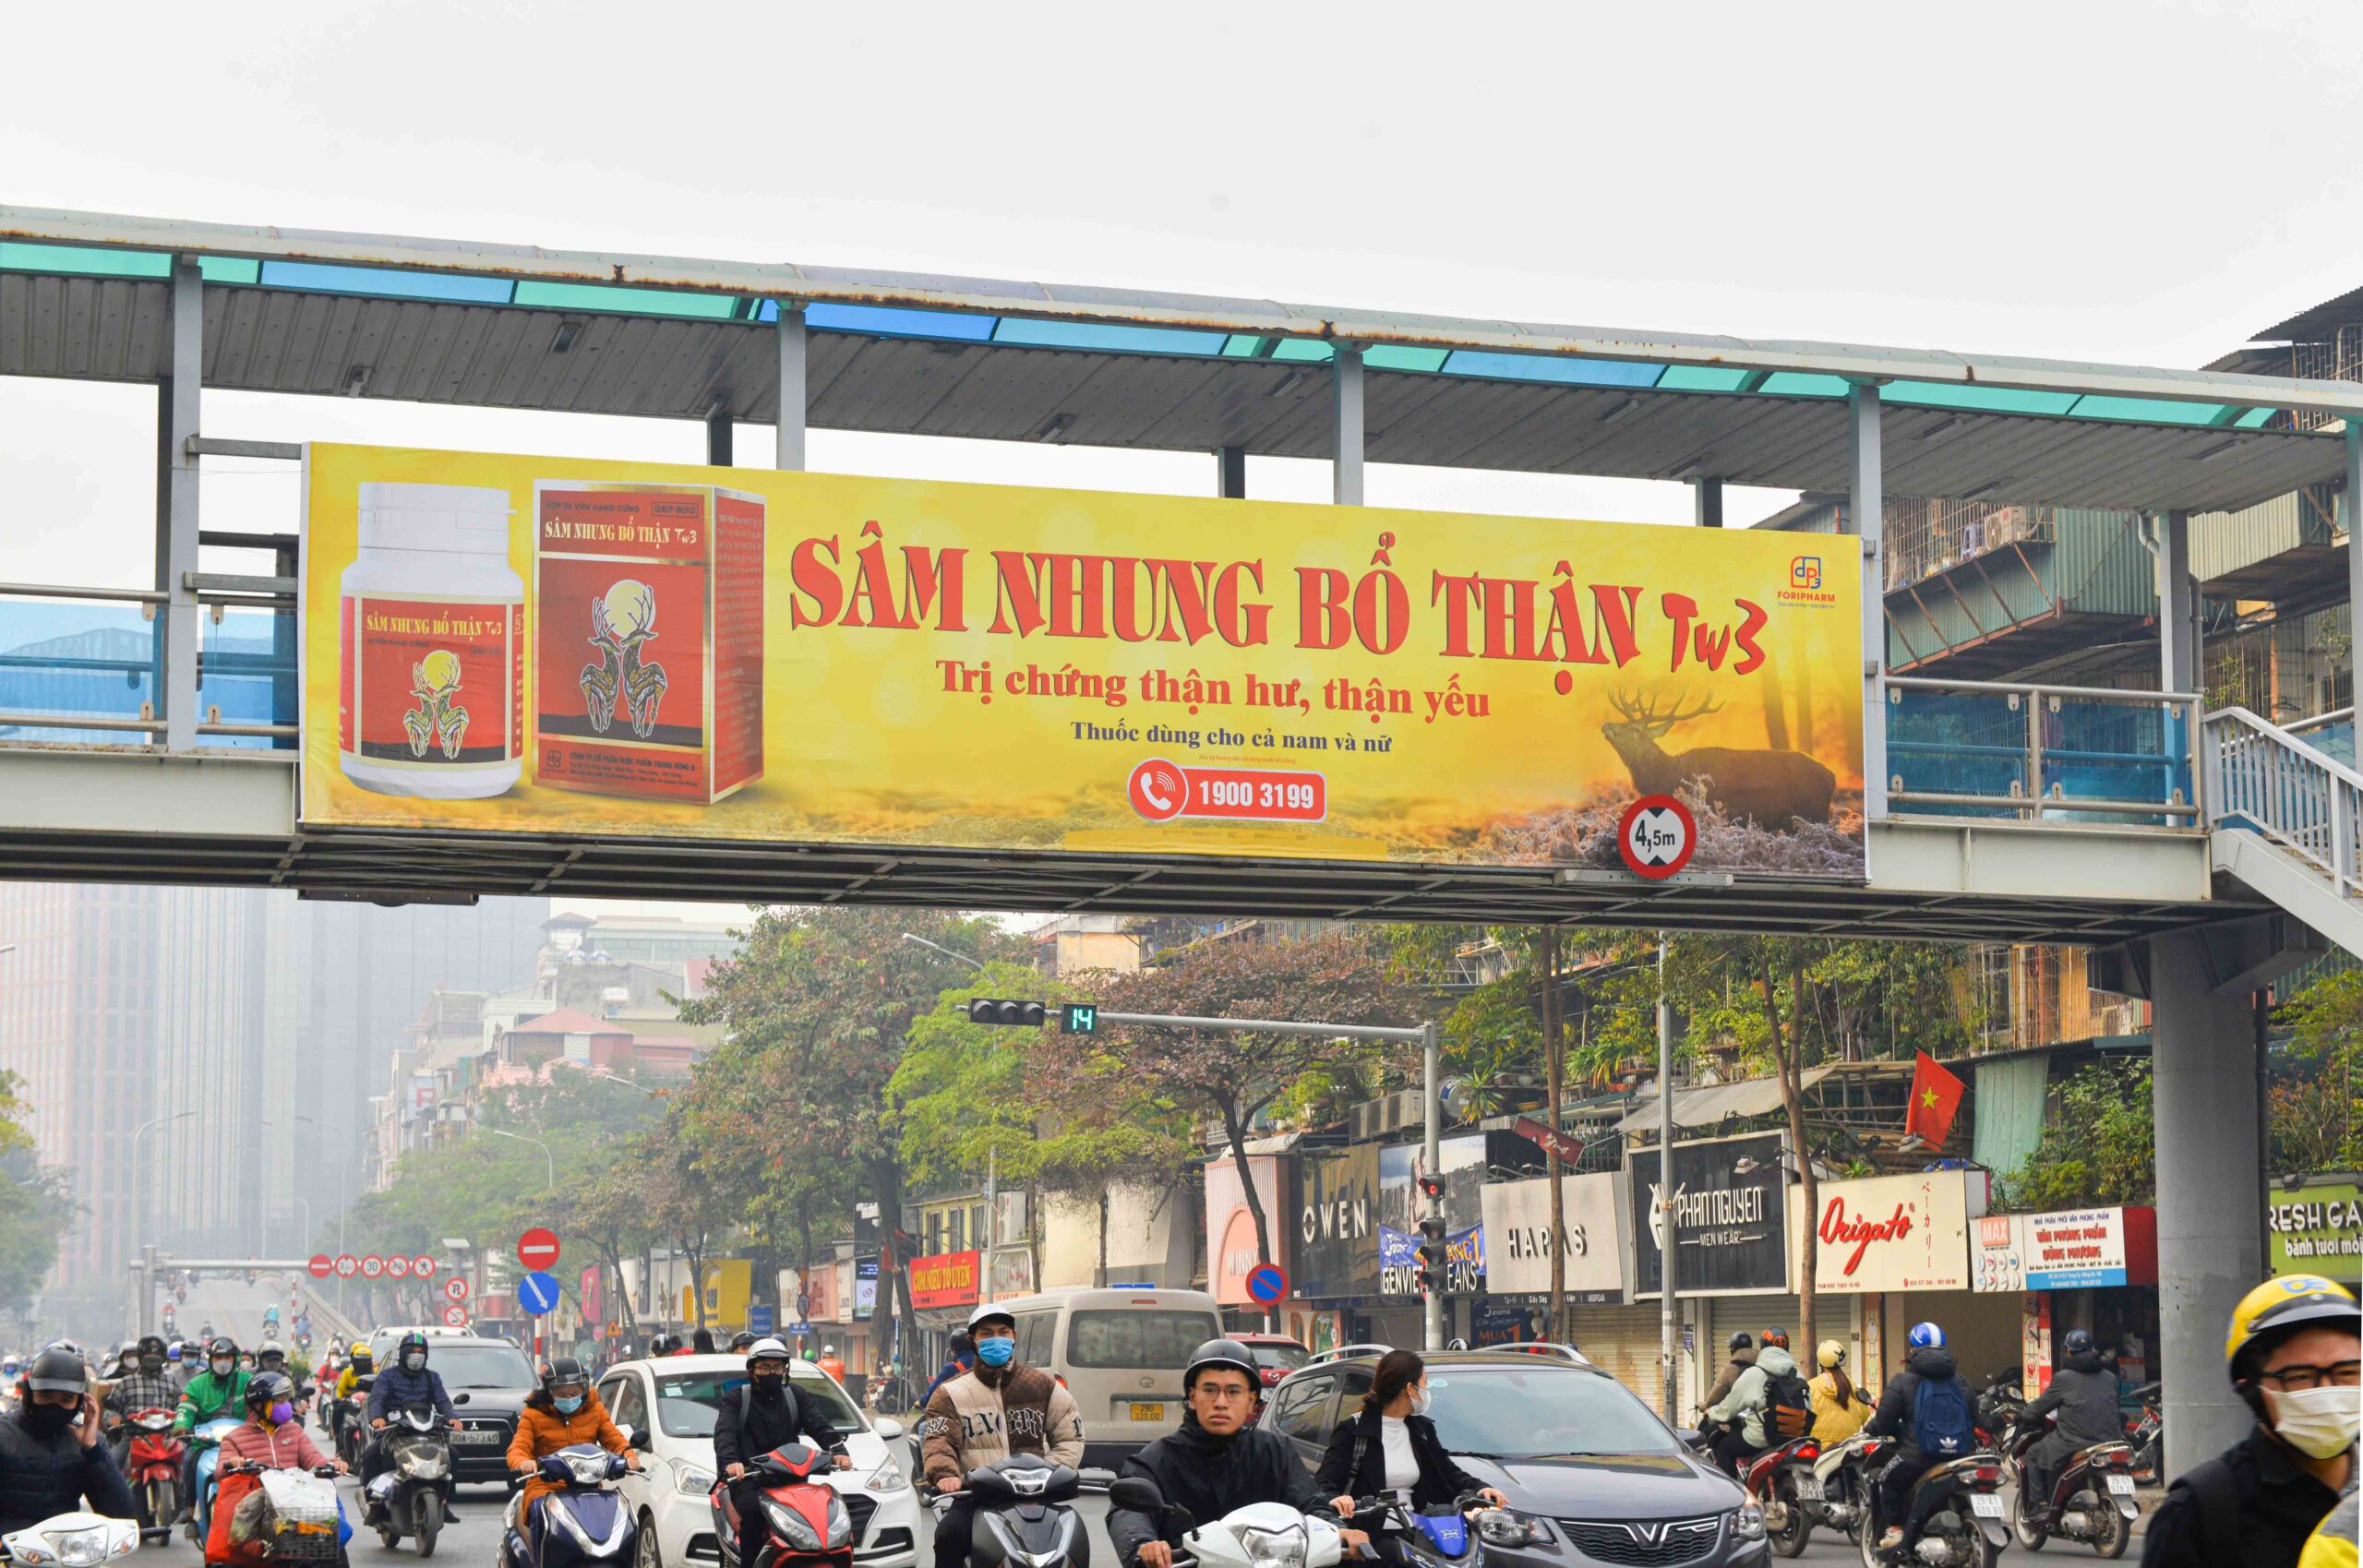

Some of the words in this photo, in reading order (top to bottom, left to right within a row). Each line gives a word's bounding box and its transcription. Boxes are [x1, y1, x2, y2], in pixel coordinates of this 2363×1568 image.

[545, 517, 570, 538] SÂM
[574, 522, 615, 541] NHUNG
[618, 515, 635, 543] BỔ
[638, 521, 670, 550] THẬN
[790, 520, 969, 631] SÂM
[987, 550, 1275, 648] NHUNG
[1293, 531, 1411, 656] BỔ
[1431, 560, 1644, 696] THẬN
[1778, 591, 1835, 603] FORIPHARM
[366, 611, 388, 631] SÂM
[390, 616, 430, 635] NHUNG
[433, 610, 450, 635] BỔ
[452, 616, 482, 641] THẬN
[935, 659, 992, 704] Trị
[1005, 663, 1127, 707] chứng
[1140, 668, 1232, 715] thận
[1245, 673, 1311, 717] hư,
[1324, 677, 1413, 724] thận
[1423, 673, 1491, 724] yếu
[1071, 717, 1140, 744] Thuốc
[1146, 724, 1201, 749] dùng
[1206, 728, 1245, 748] cho
[1252, 726, 1276, 749] cả
[1281, 733, 1327, 750] nam
[1333, 732, 1356, 751] và
[1363, 733, 1392, 753] nữ
[1199, 780, 1253, 807] 1900
[1260, 783, 1313, 808] 3199
[1635, 820, 1675, 854] 4,5m
[1072, 1008, 1093, 1031] 14
[1302, 1199, 1367, 1244] OWEN
[1678, 1191, 1709, 1227] PHAN
[2270, 1203, 2321, 1232] RESH
[2327, 1200, 2362, 1228] GA
[1507, 1225, 1587, 1258] HAPS
[1700, 1232, 1717, 1247] MEN
[1717, 1230, 1740, 1246] WEAR
[1983, 1221, 2009, 1243] MAX
[2285, 1238, 2313, 1256] bánh
[366, 1261, 378, 1272] 30
[1447, 1263, 1477, 1292] EANS
[1484, 1306, 1511, 1318] Jeans
[1479, 1329, 1507, 1342] MUA
[1507, 1323, 1521, 1352] 1
